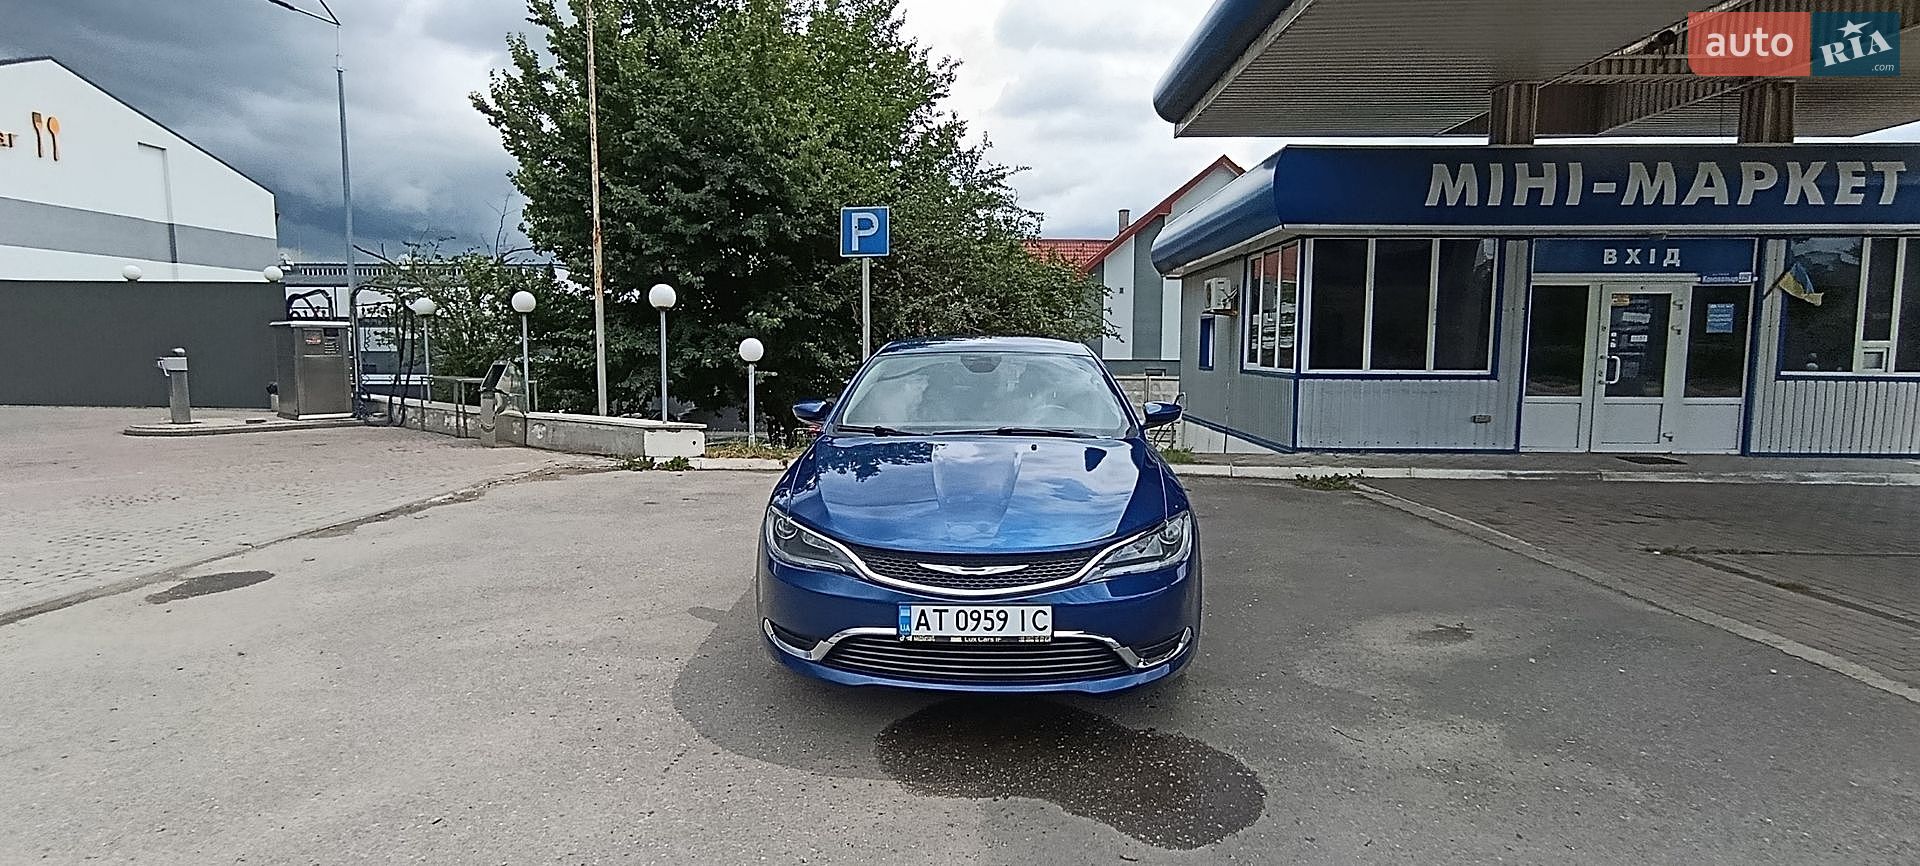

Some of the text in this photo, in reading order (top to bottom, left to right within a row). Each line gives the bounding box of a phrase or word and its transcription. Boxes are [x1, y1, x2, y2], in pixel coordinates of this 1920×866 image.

[1425, 160, 1907, 207] МІНІ-МАРКЕТ
[851, 212, 879, 251] P
[1602, 247, 1682, 268] ВХІД
[900, 623, 911, 633] UA
[914, 608, 1049, 632] AT 0959 IC
